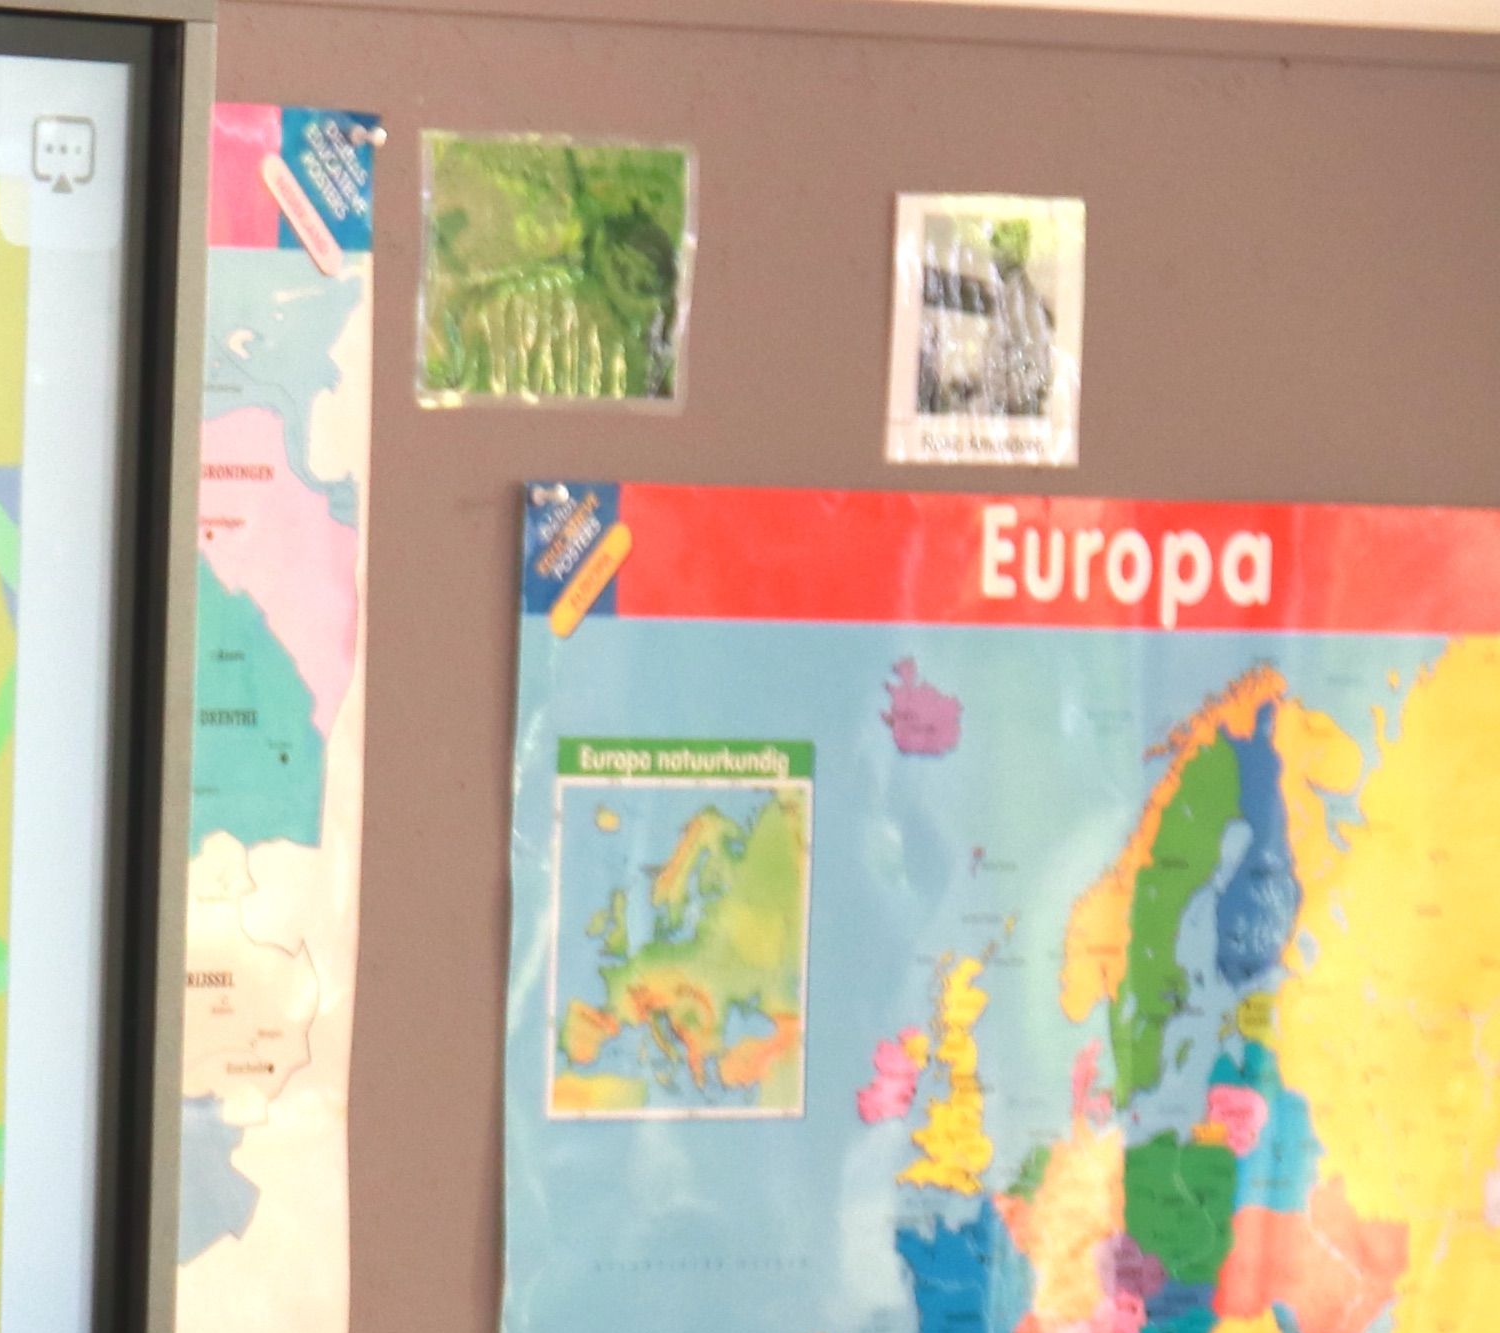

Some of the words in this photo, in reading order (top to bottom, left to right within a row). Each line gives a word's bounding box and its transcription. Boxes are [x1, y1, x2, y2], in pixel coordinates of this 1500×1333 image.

[980, 503, 1274, 630] Europa
[578, 745, 652, 778] Europa
[656, 746, 791, 779] natuurkundig
